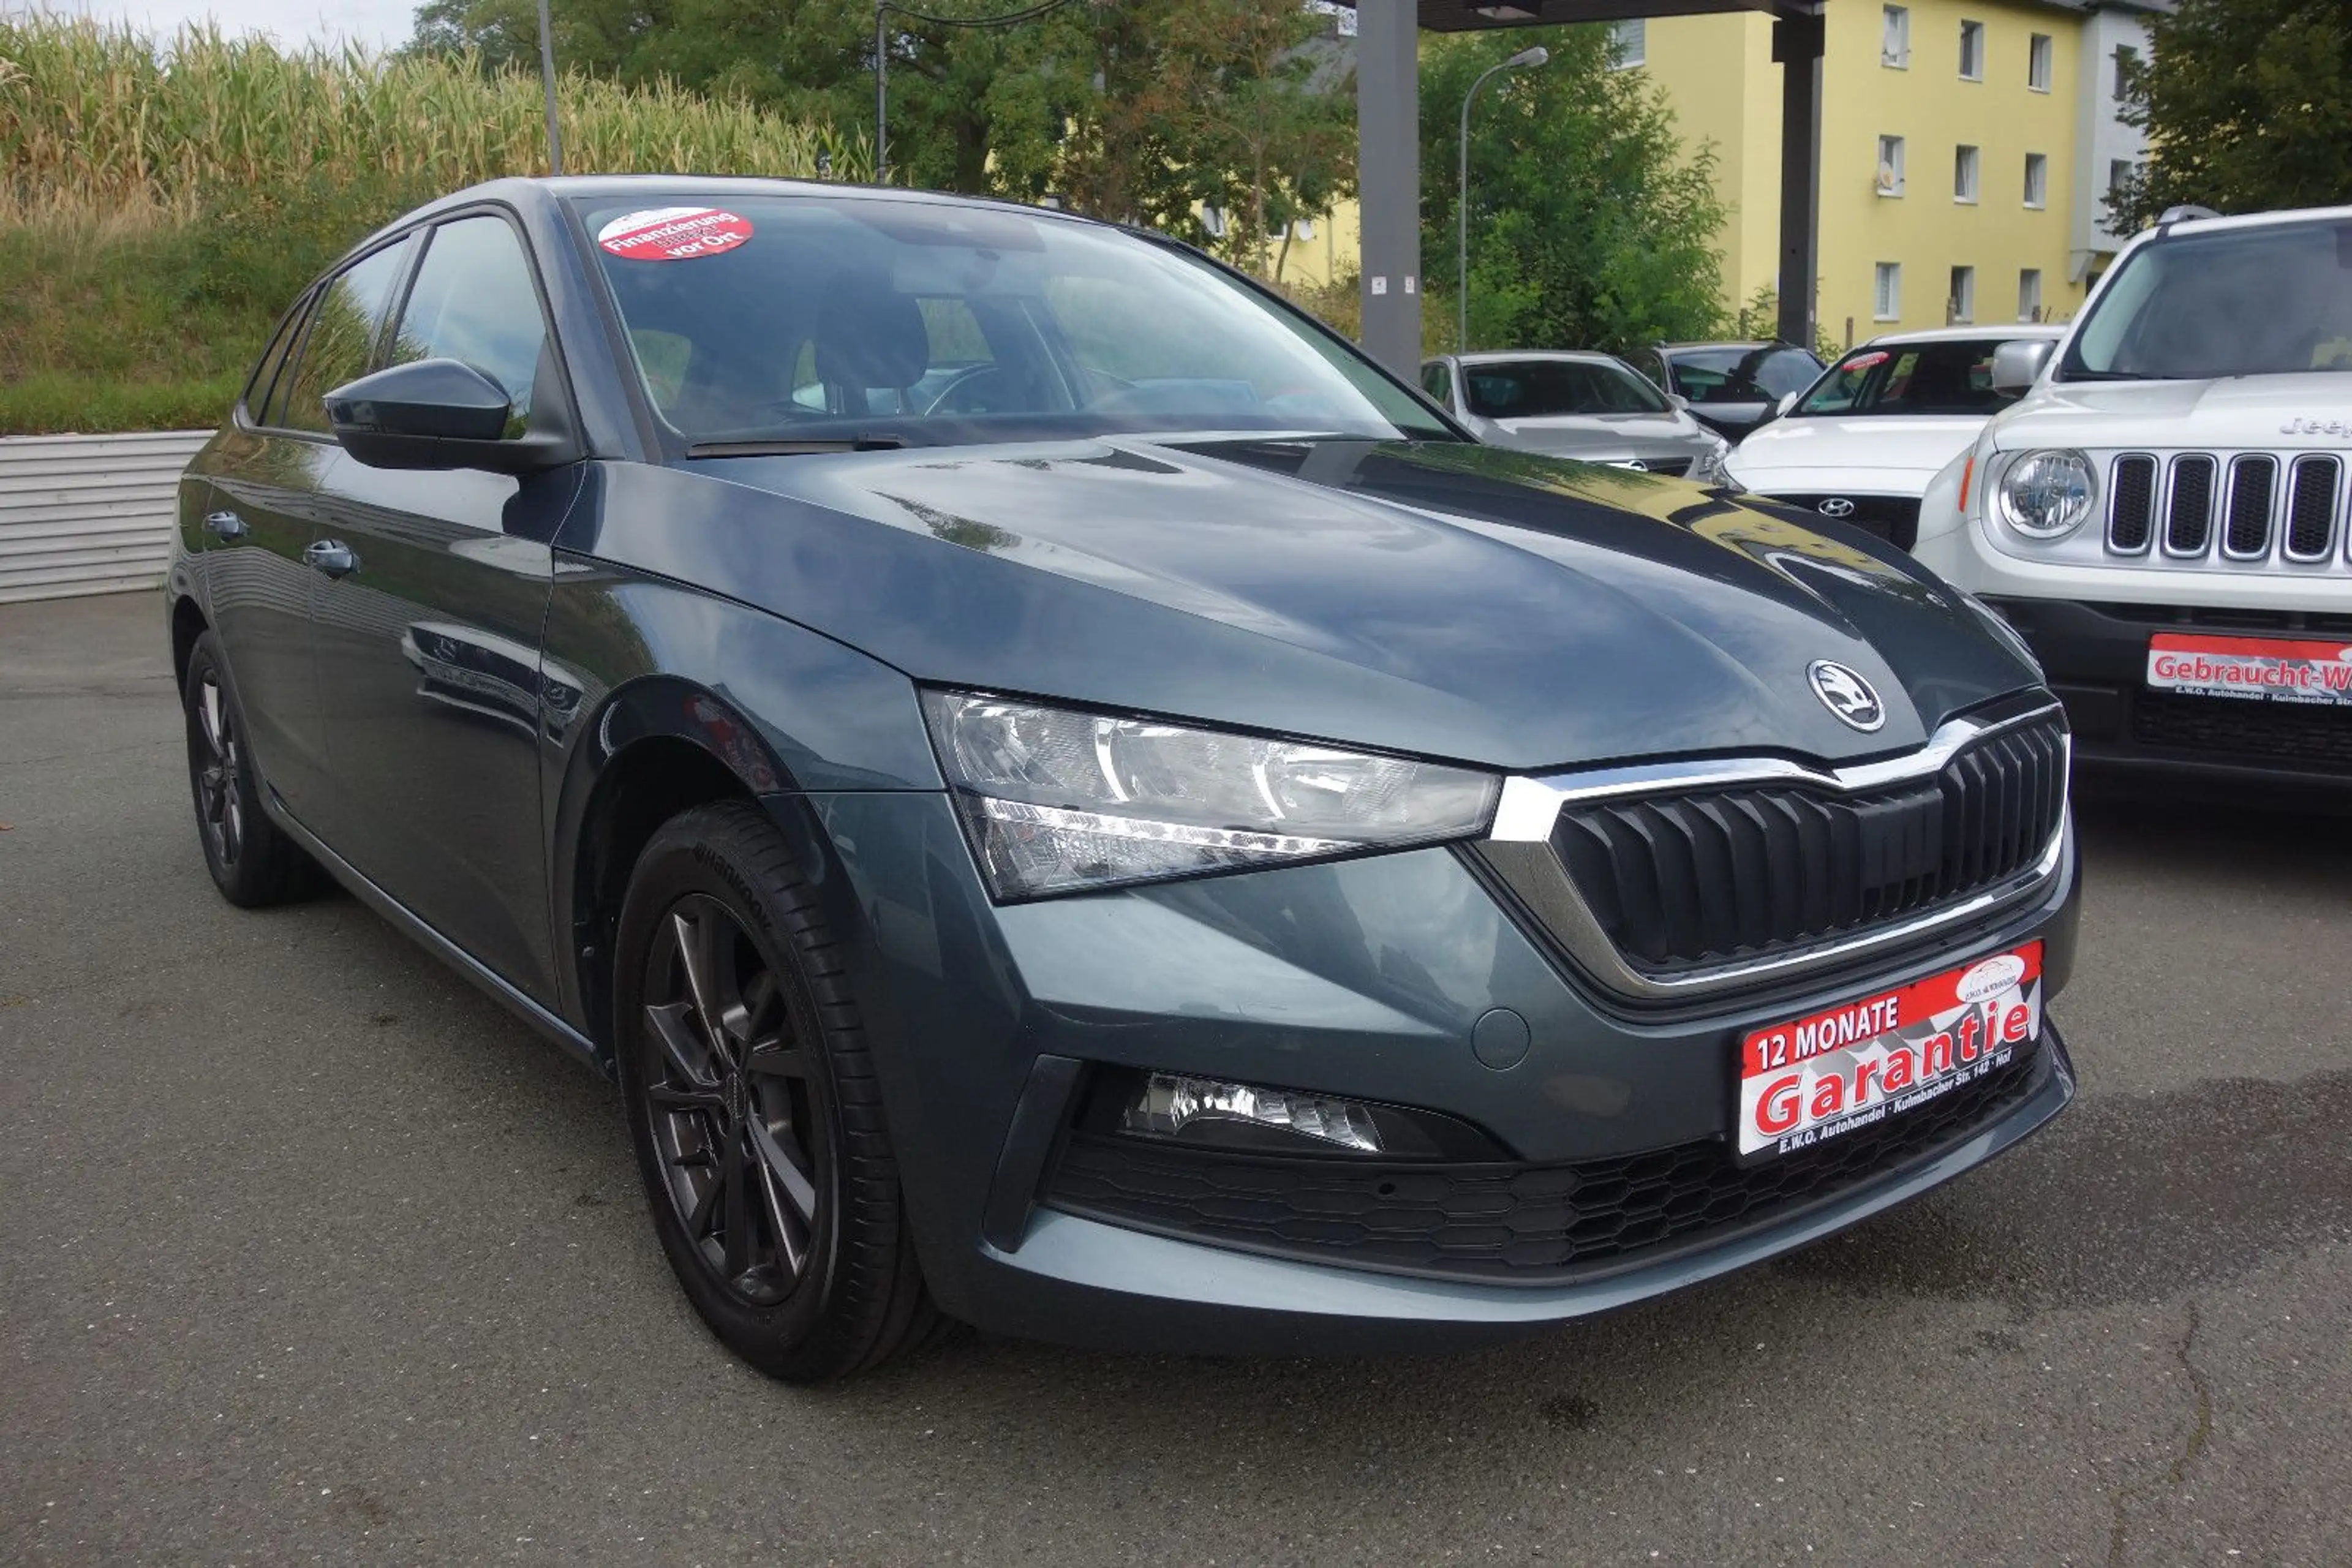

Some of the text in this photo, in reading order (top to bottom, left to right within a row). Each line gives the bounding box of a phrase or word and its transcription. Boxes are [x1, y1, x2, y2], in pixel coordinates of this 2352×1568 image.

[604, 212, 739, 251] Finanzierung
[665, 242, 704, 256] vor
[701, 232, 743, 246] Ort
[2154, 656, 2352, 690] Gebraucht-W
[2207, 689, 2264, 701] Autohandel
[2272, 693, 2334, 705] Kulmbacher
[1757, 996, 1898, 1070] 12 MONATE
[1755, 1001, 2032, 1136] Garantie
[1779, 1130, 1816, 1154] E.W.O.
[1820, 1105, 1886, 1140] Autohandel
[1893, 1078, 1954, 1114] Kulmbacher
[1955, 1071, 1971, 1087] Str.
